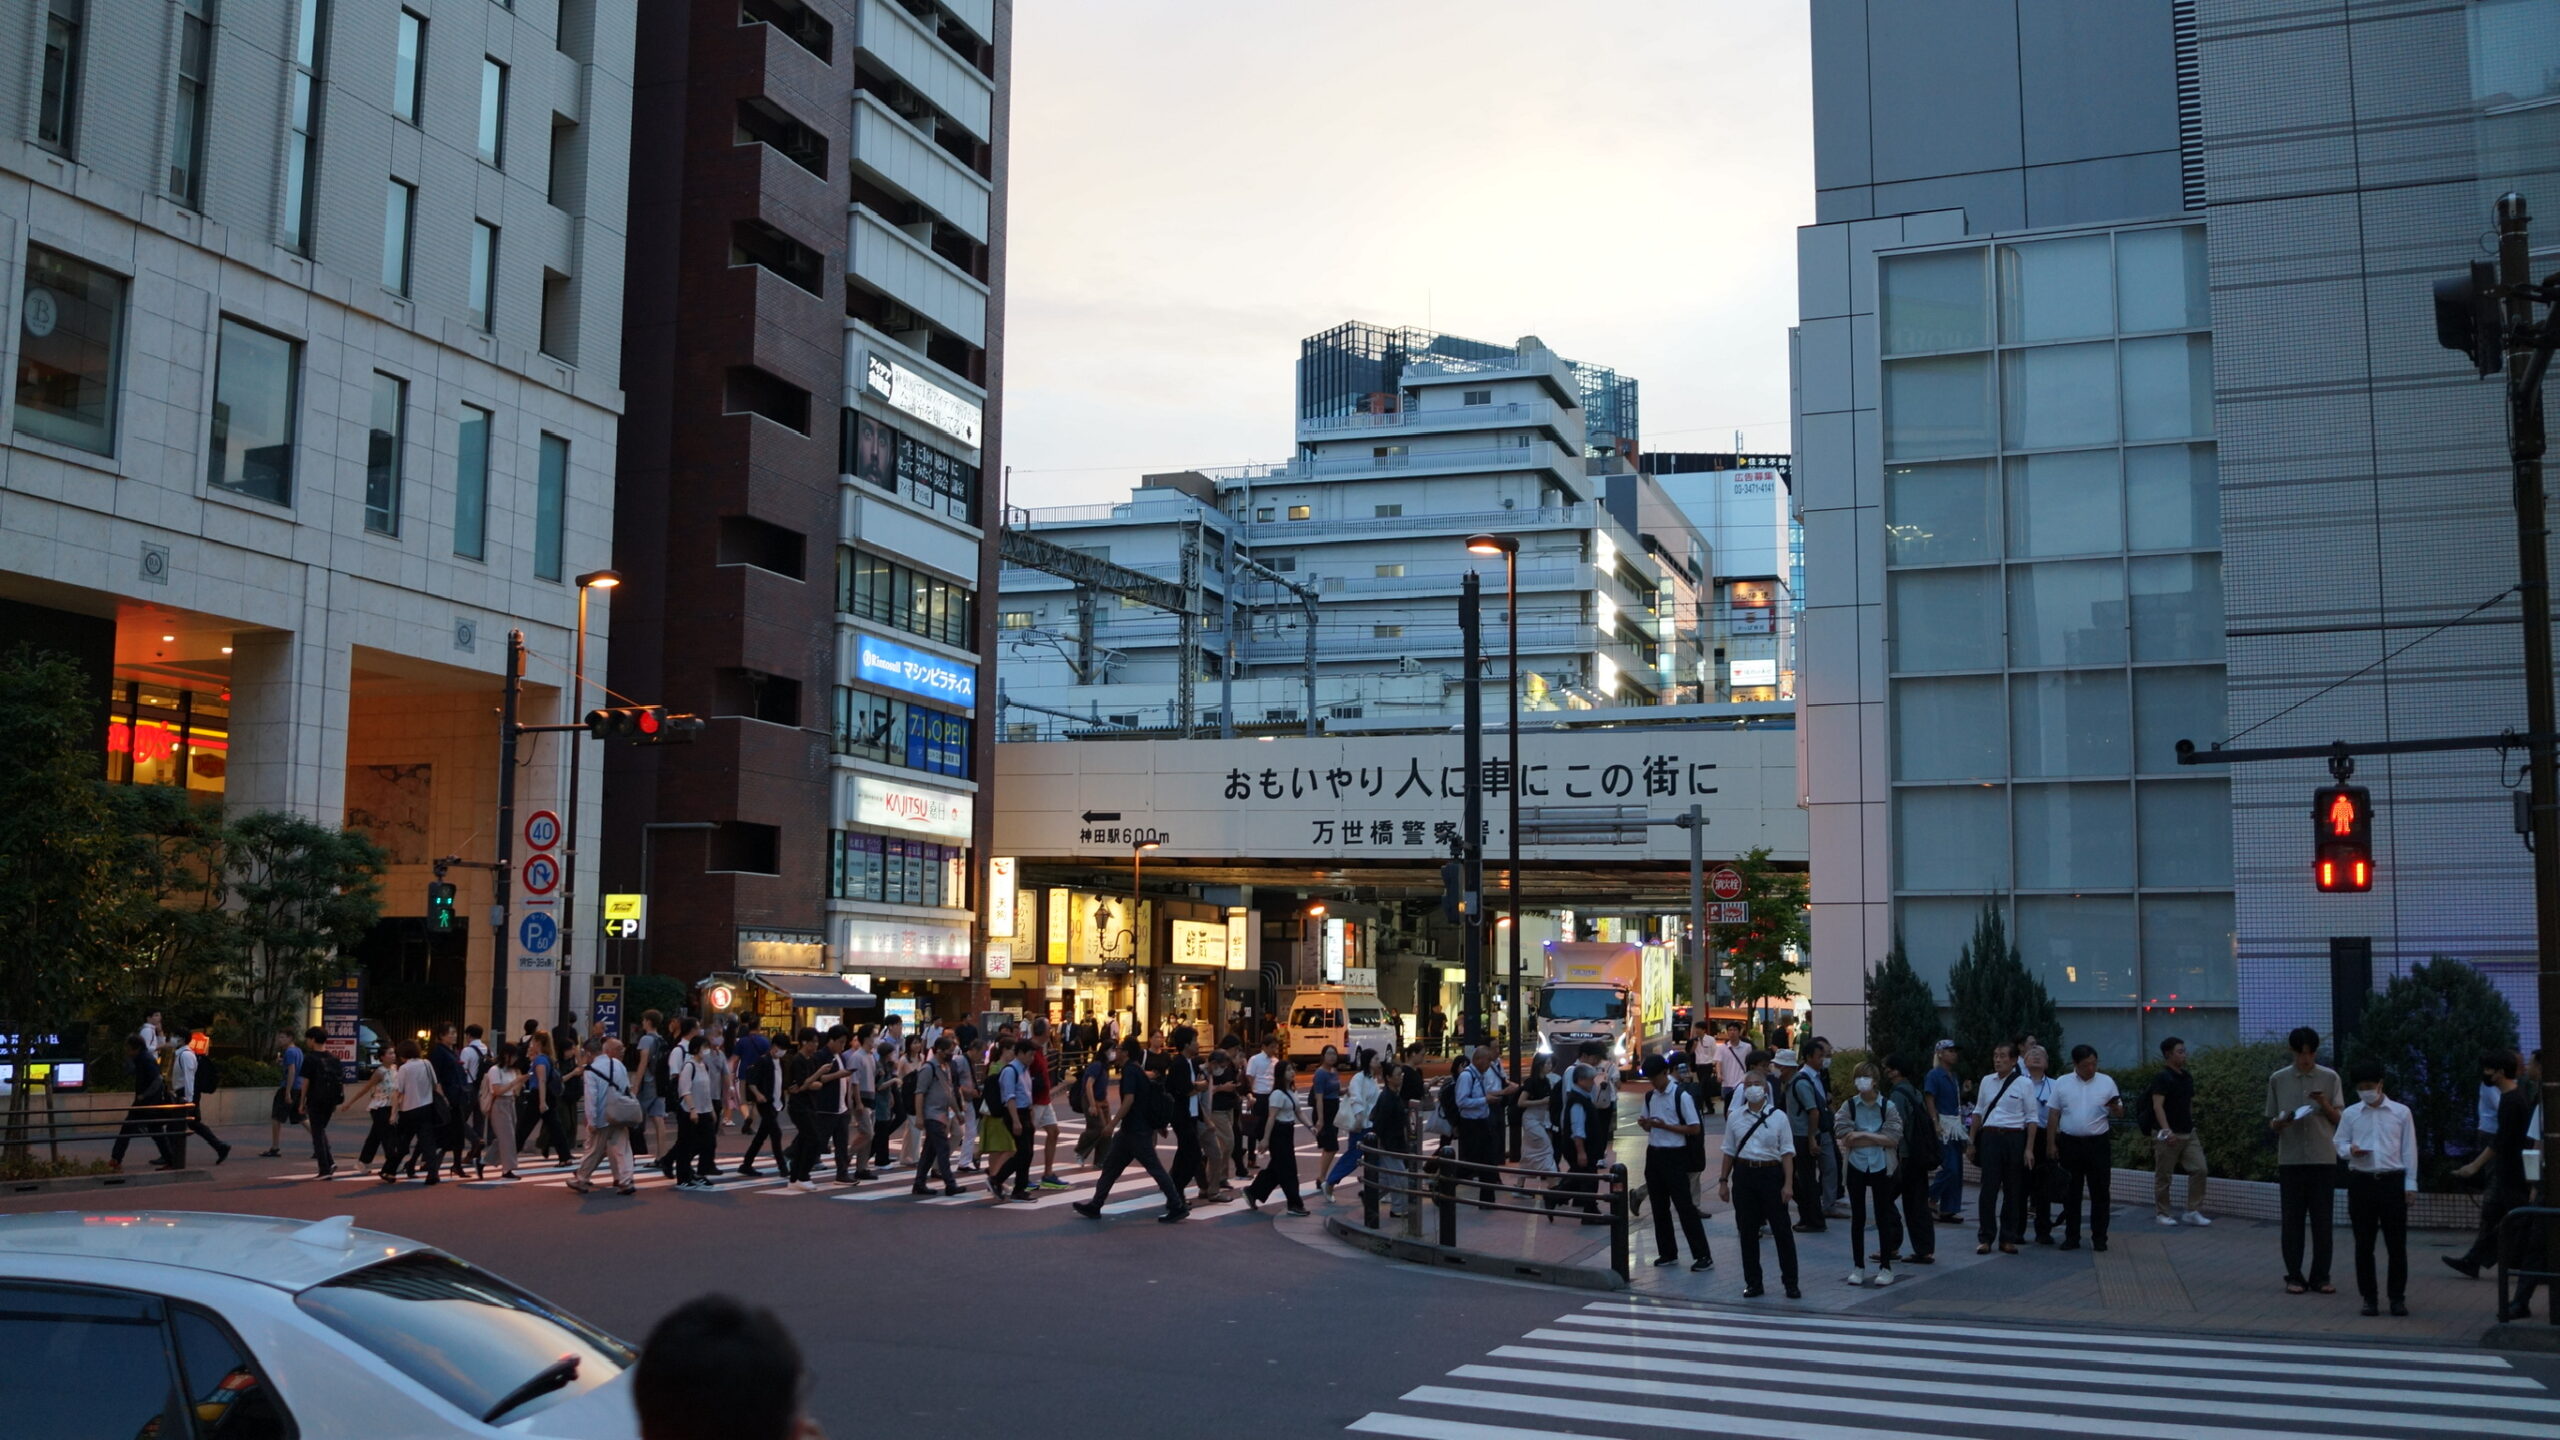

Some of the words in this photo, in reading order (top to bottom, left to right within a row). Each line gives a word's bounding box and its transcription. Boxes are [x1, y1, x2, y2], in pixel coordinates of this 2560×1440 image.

[1734, 472, 1773, 482] 広告募集
[1734, 482, 1775, 495] 03-3471-4141
[903, 661, 971, 695] マシンピラティス
[886, 792, 928, 817] KAJITSU
[533, 822, 553, 841] 40
[1715, 879, 1739, 890] 消火栓
[528, 923, 542, 949] P
[622, 919, 638, 938] P
[901, 930, 917, 963] 薬
[990, 955, 1006, 973] 薬
[597, 1005, 616, 1015] 入口
